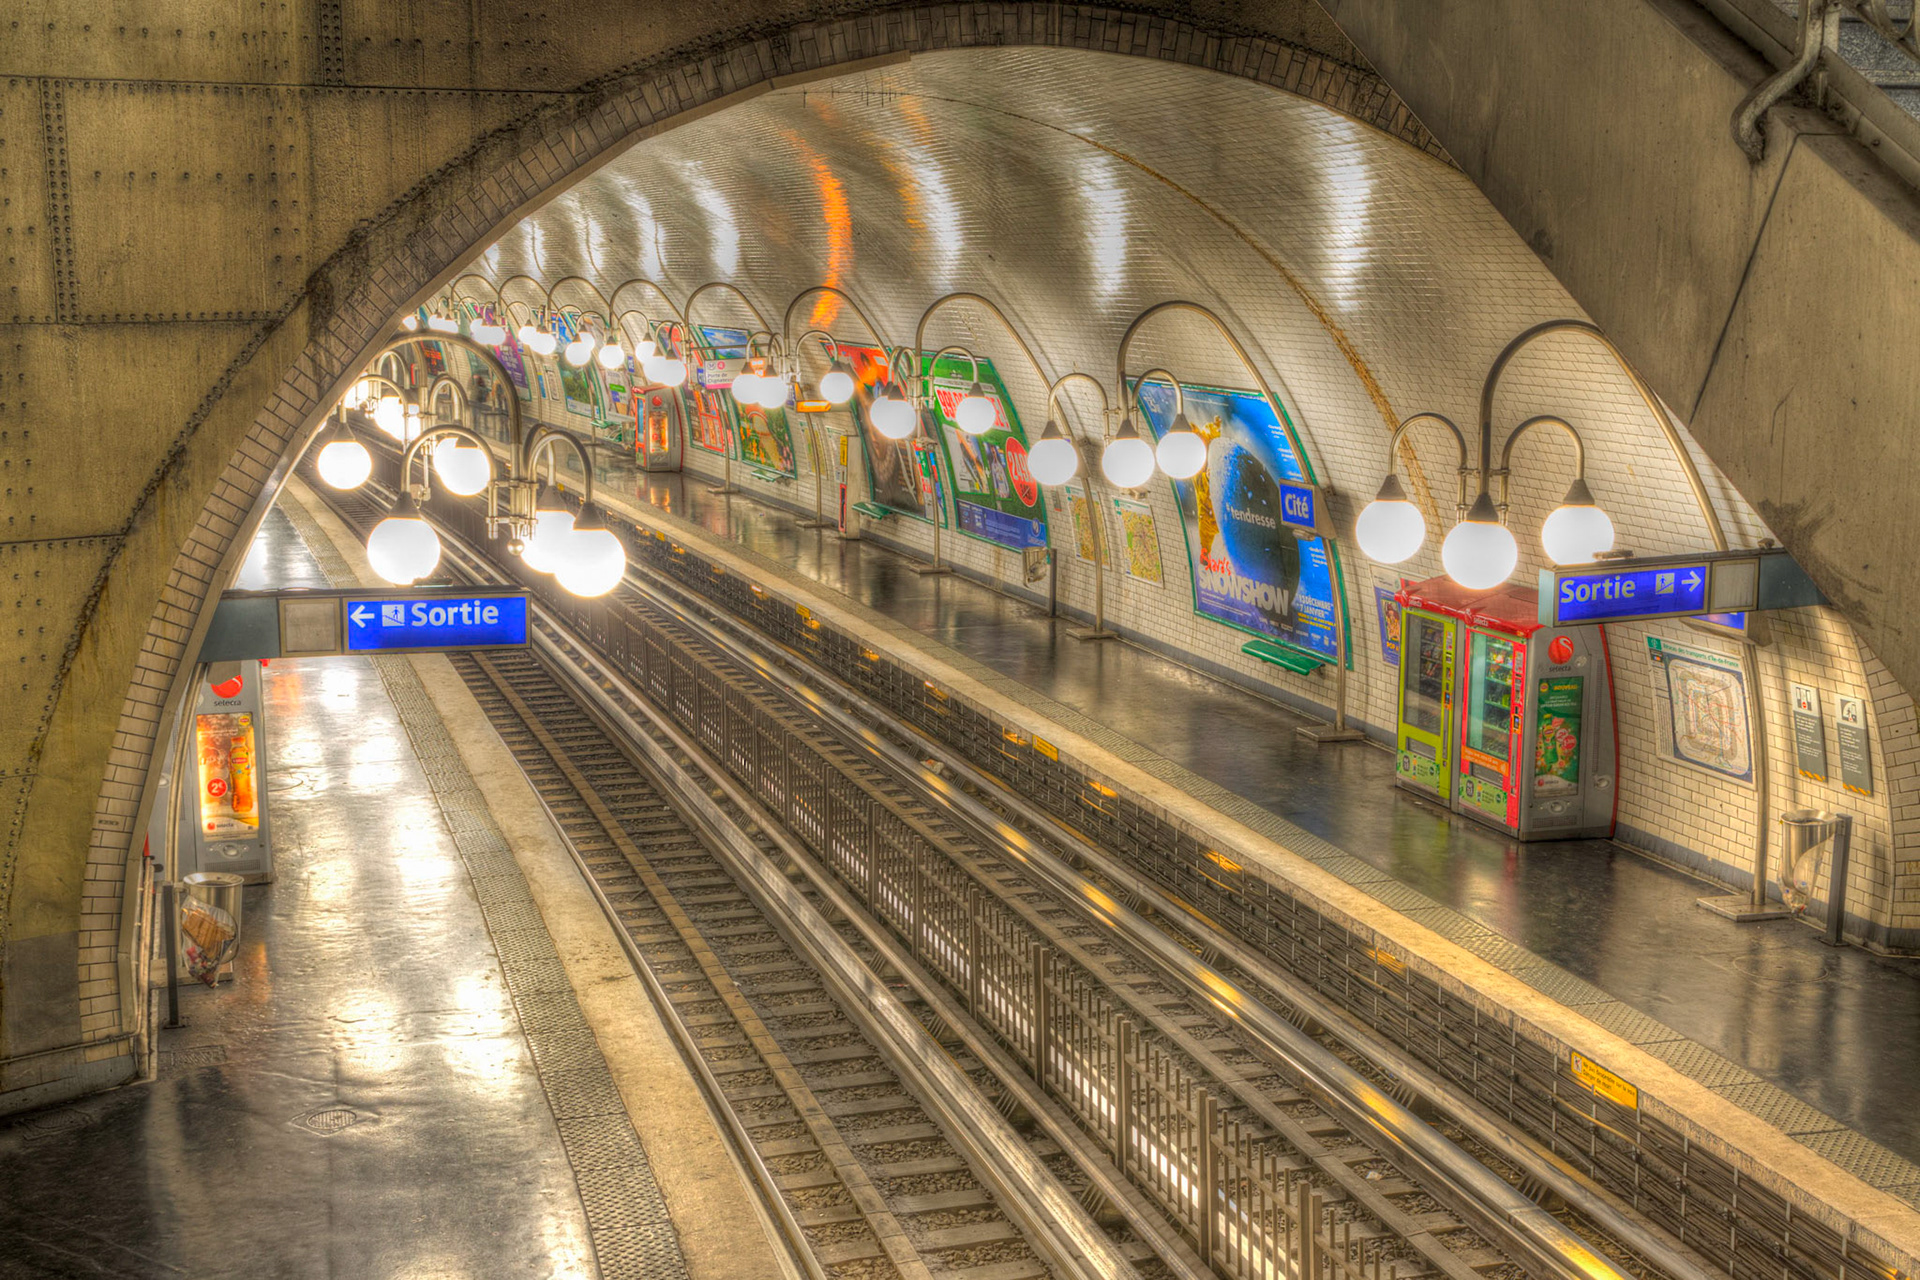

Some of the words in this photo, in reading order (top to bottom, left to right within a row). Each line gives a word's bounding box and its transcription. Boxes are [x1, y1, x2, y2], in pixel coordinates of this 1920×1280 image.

[1285, 493, 1309, 519] Cité
[1198, 564, 1289, 616] SNOWSHOW
[1560, 575, 1636, 604] Sortie
[411, 600, 499, 627] Sortie
[213, 699, 242, 707] selecta
[211, 782, 223, 793] 2€
